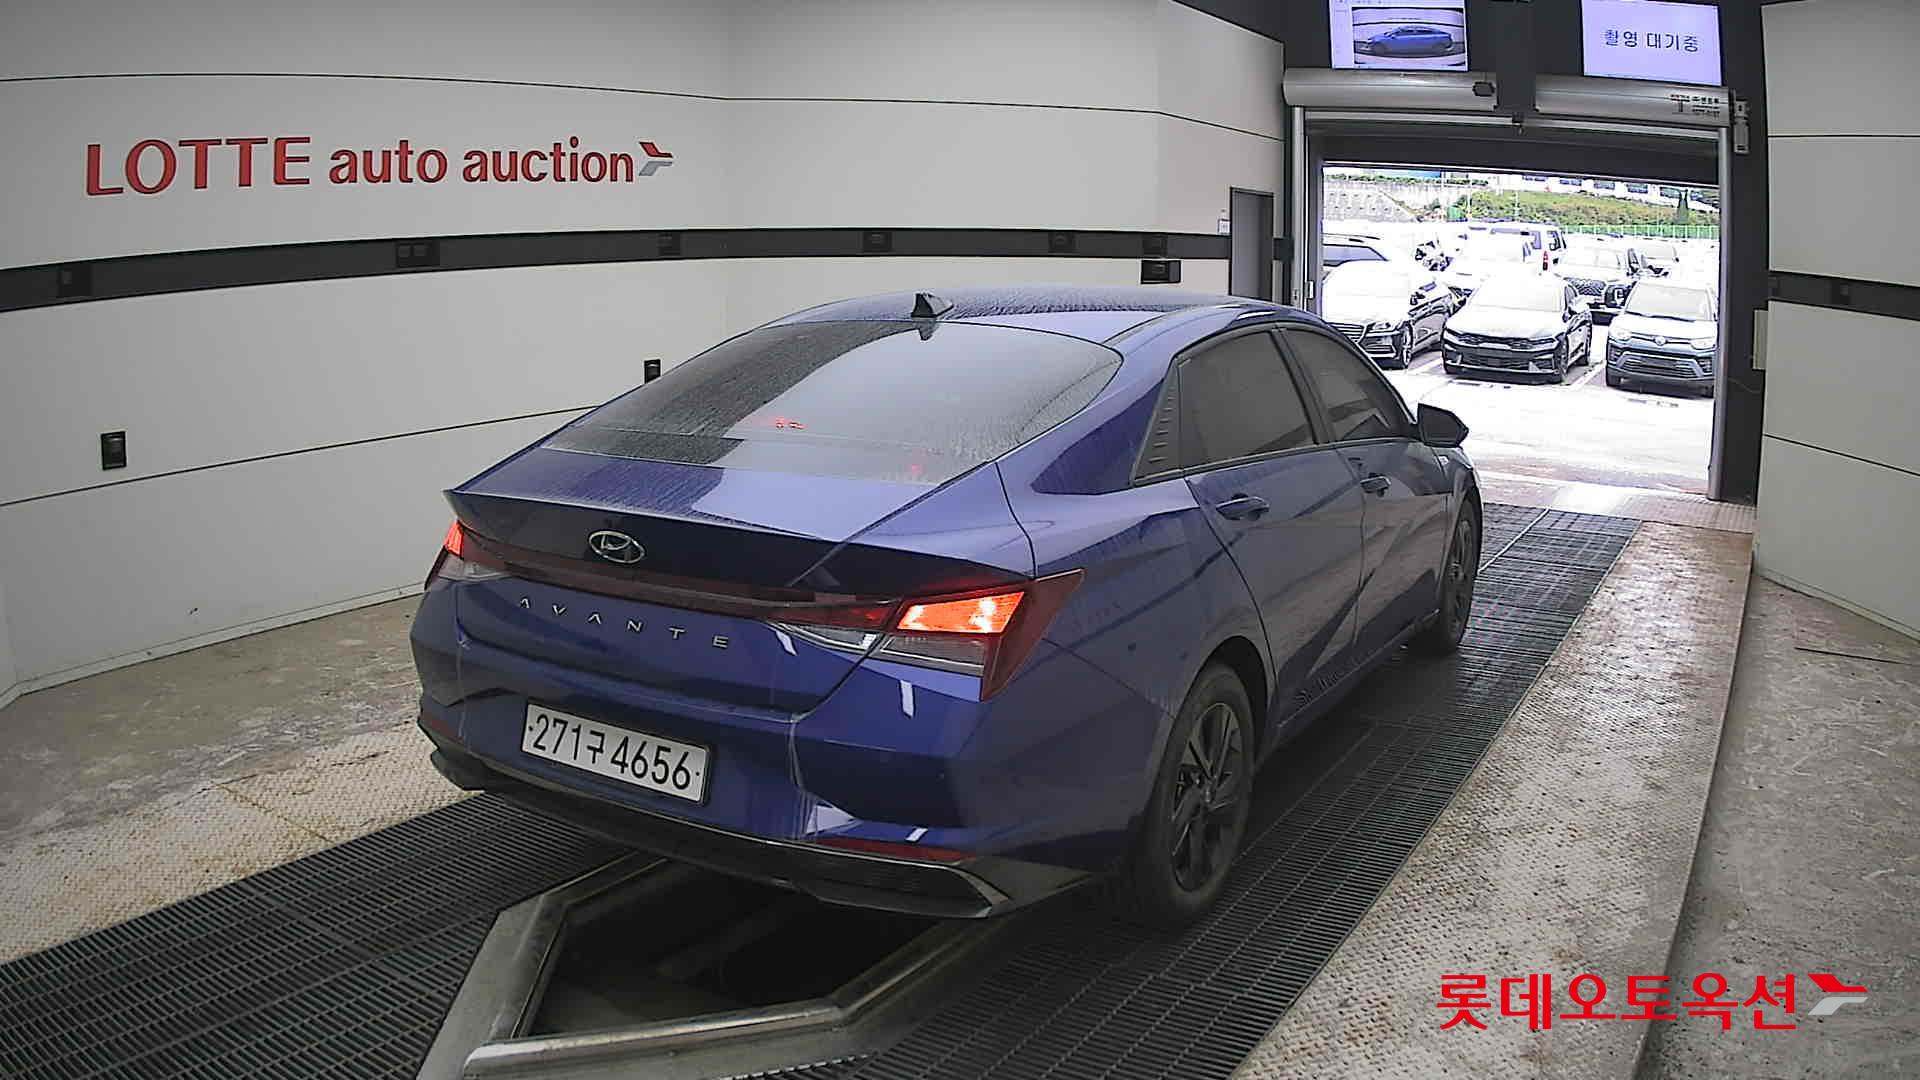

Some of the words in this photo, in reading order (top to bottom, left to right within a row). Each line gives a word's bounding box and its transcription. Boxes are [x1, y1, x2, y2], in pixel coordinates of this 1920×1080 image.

[1646, 32, 1698, 52] 대기중
[86, 136, 311, 196] LOTTE
[329, 139, 447, 184] auto
[462, 136, 634, 183] auction
[520, 597, 729, 649] AVANTE
[532, 713, 692, 790] 271구4656
